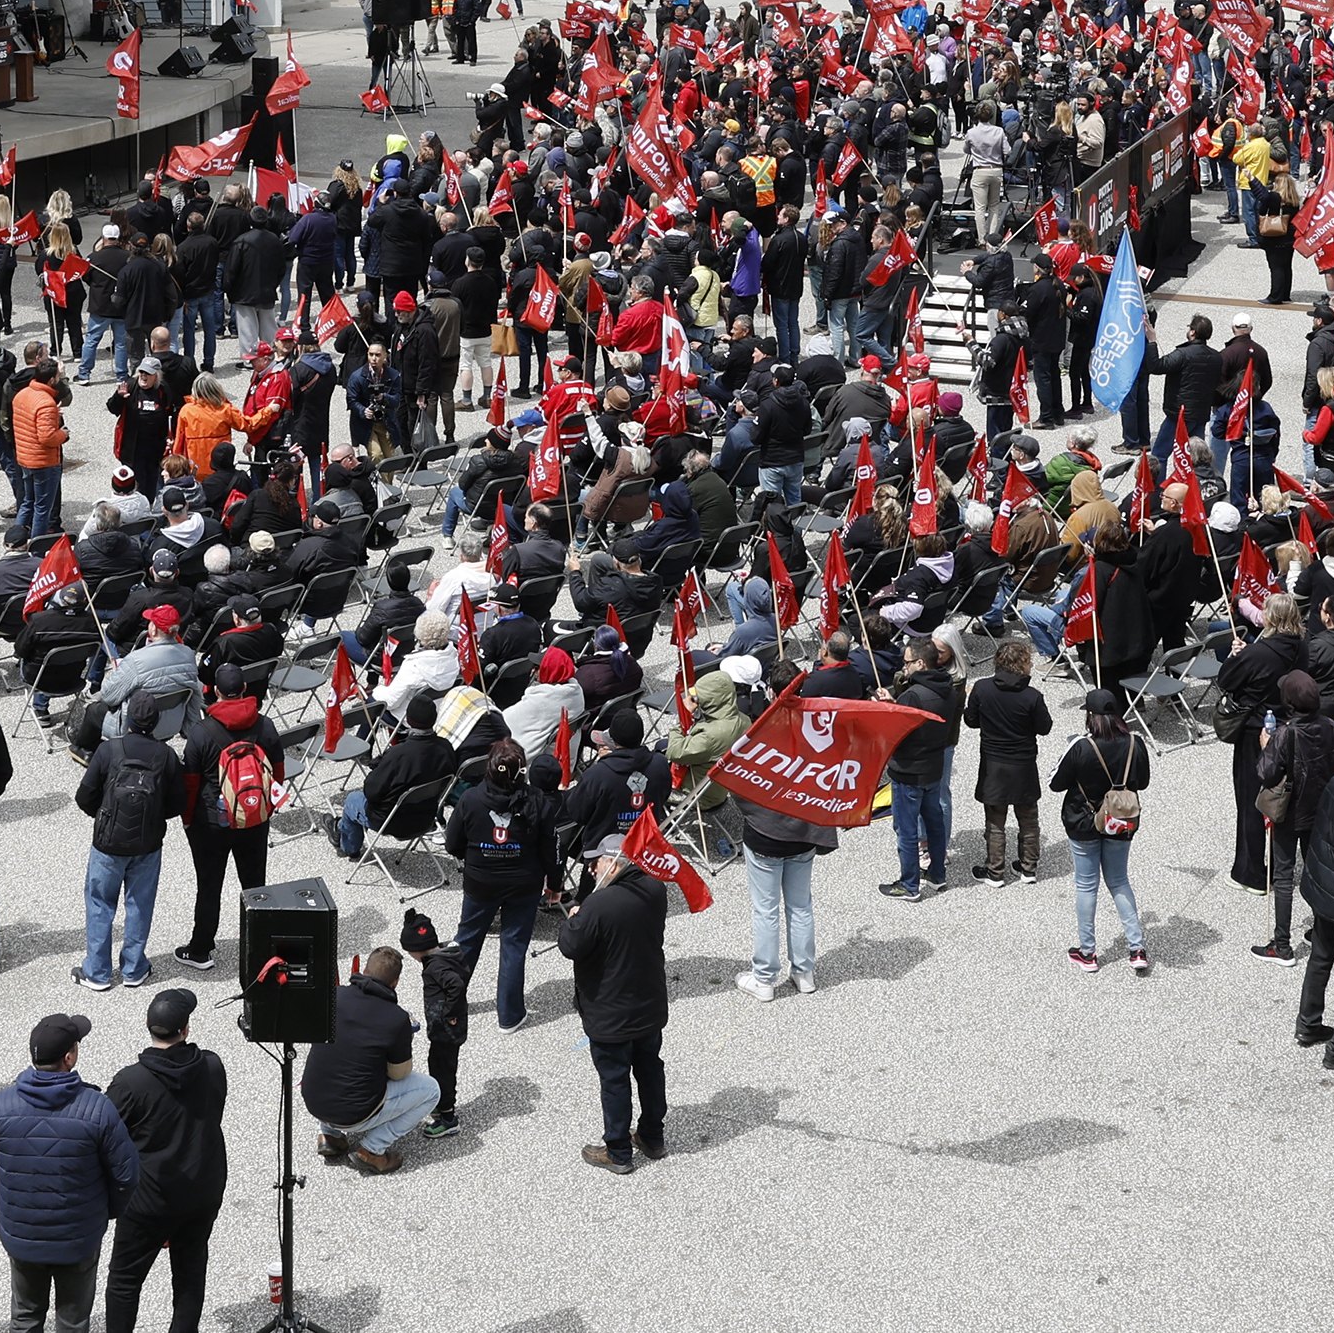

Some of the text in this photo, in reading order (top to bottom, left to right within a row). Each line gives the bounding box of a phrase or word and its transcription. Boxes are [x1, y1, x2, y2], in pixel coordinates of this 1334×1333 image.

[1168, 83, 1187, 107] FOR
[1014, 388, 1027, 408] FOR
[731, 735, 860, 792] UNIFOR
[715, 758, 859, 814] eUnion lesyndicat
